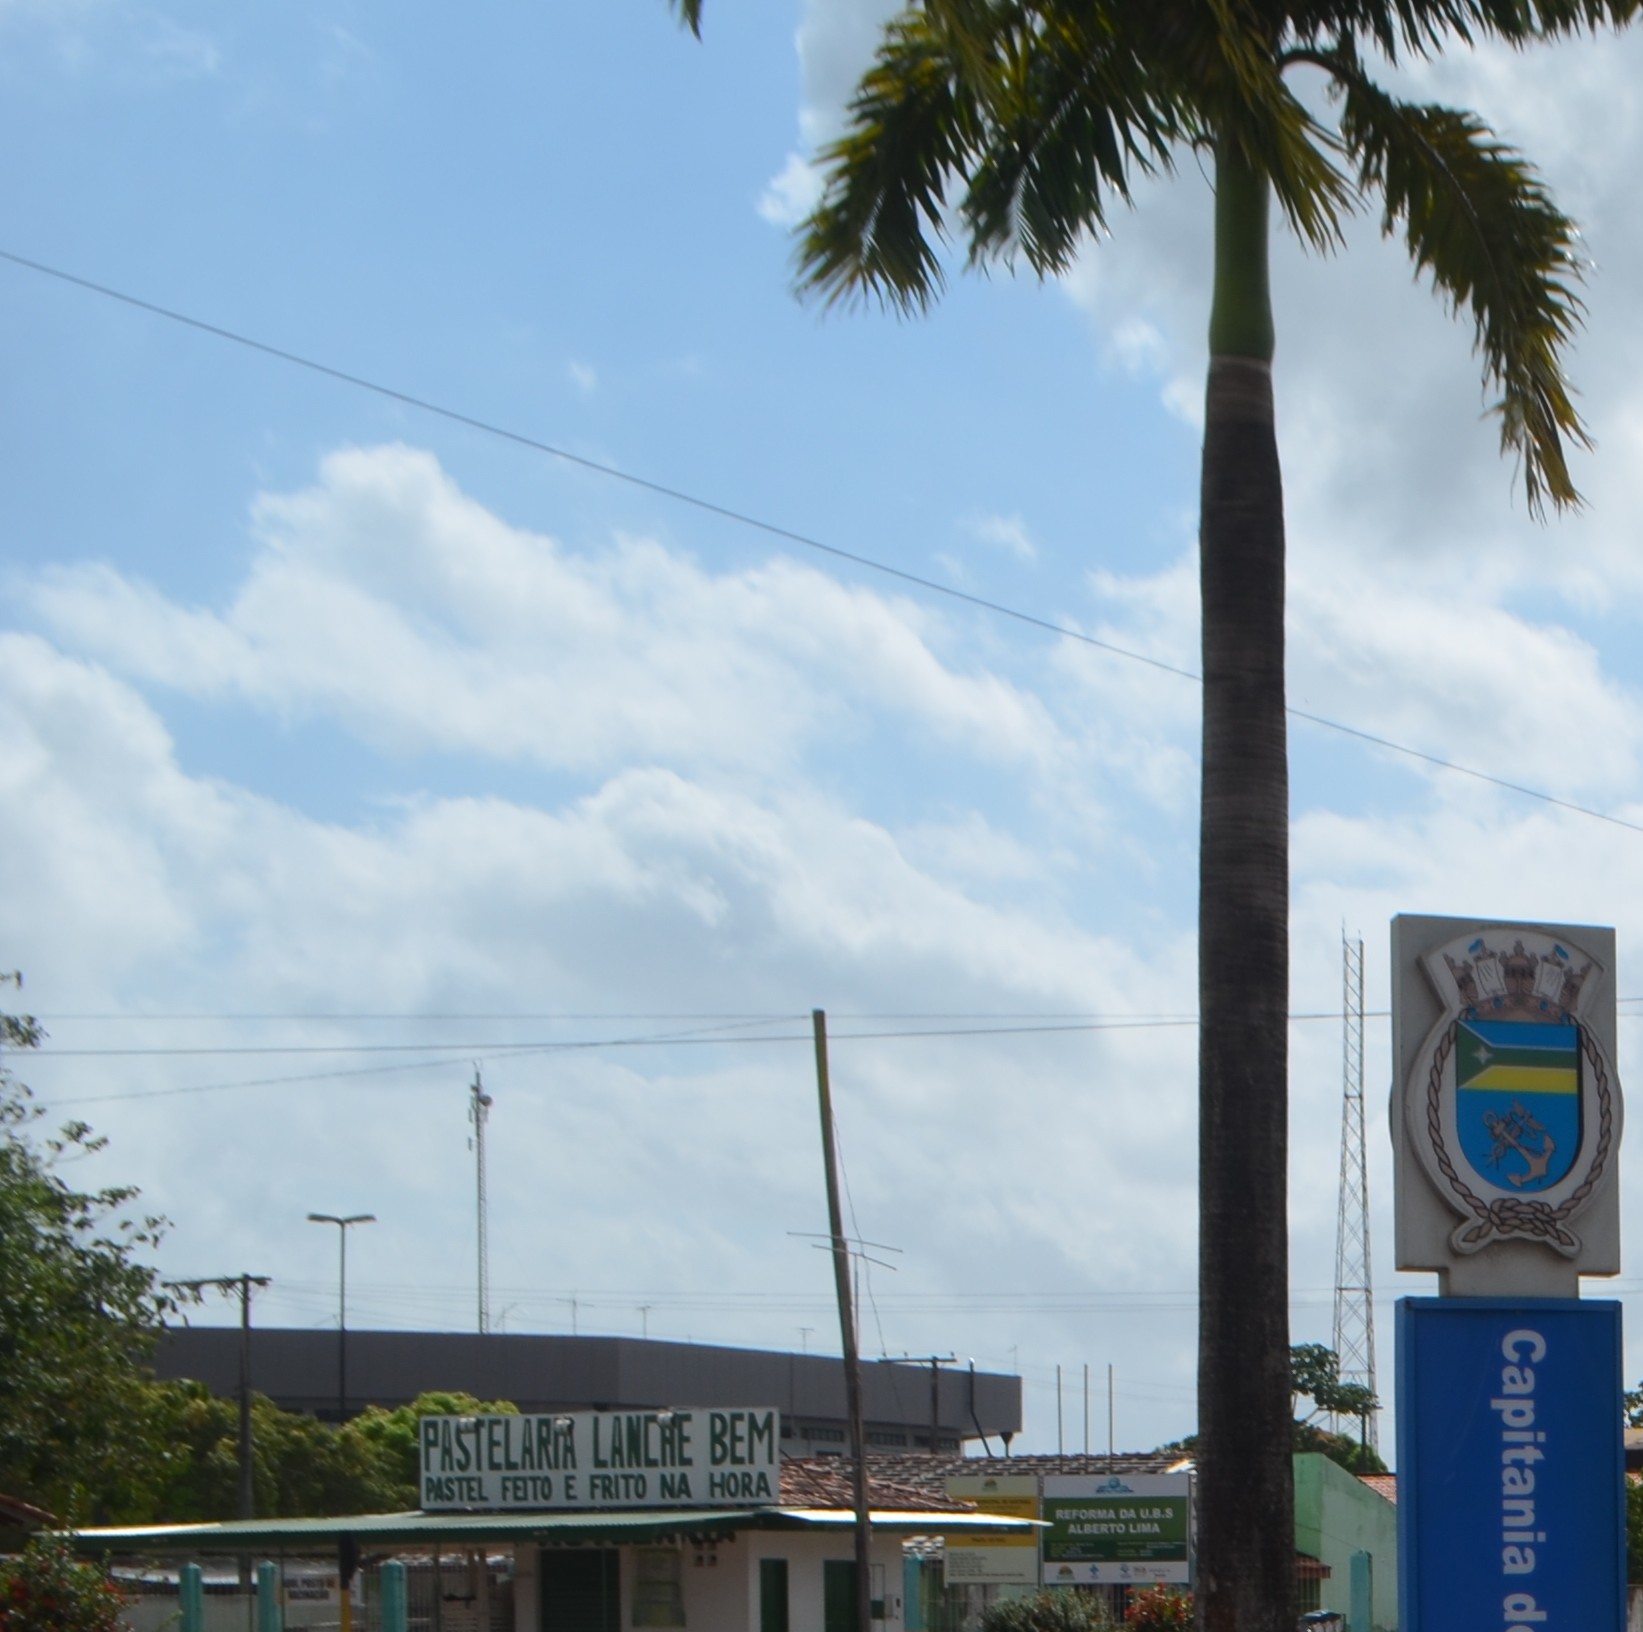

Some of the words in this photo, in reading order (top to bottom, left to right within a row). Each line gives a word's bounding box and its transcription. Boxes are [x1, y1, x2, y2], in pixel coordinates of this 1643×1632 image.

[710, 1411, 774, 1465] BEM
[1491, 1328, 1547, 1575] Capitania
[425, 1476, 489, 1503] PASTEL
[501, 1475, 552, 1501] FEITO
[565, 1475, 577, 1500] E
[589, 1473, 647, 1500] FRITO
[660, 1473, 692, 1499] NA
[709, 1471, 772, 1499] HORA
[1056, 1509, 1116, 1520] REFORMA
[1119, 1509, 1136, 1519] DA
[1068, 1523, 1126, 1534] ALBERTO
[1129, 1523, 1160, 1534] LIMA
